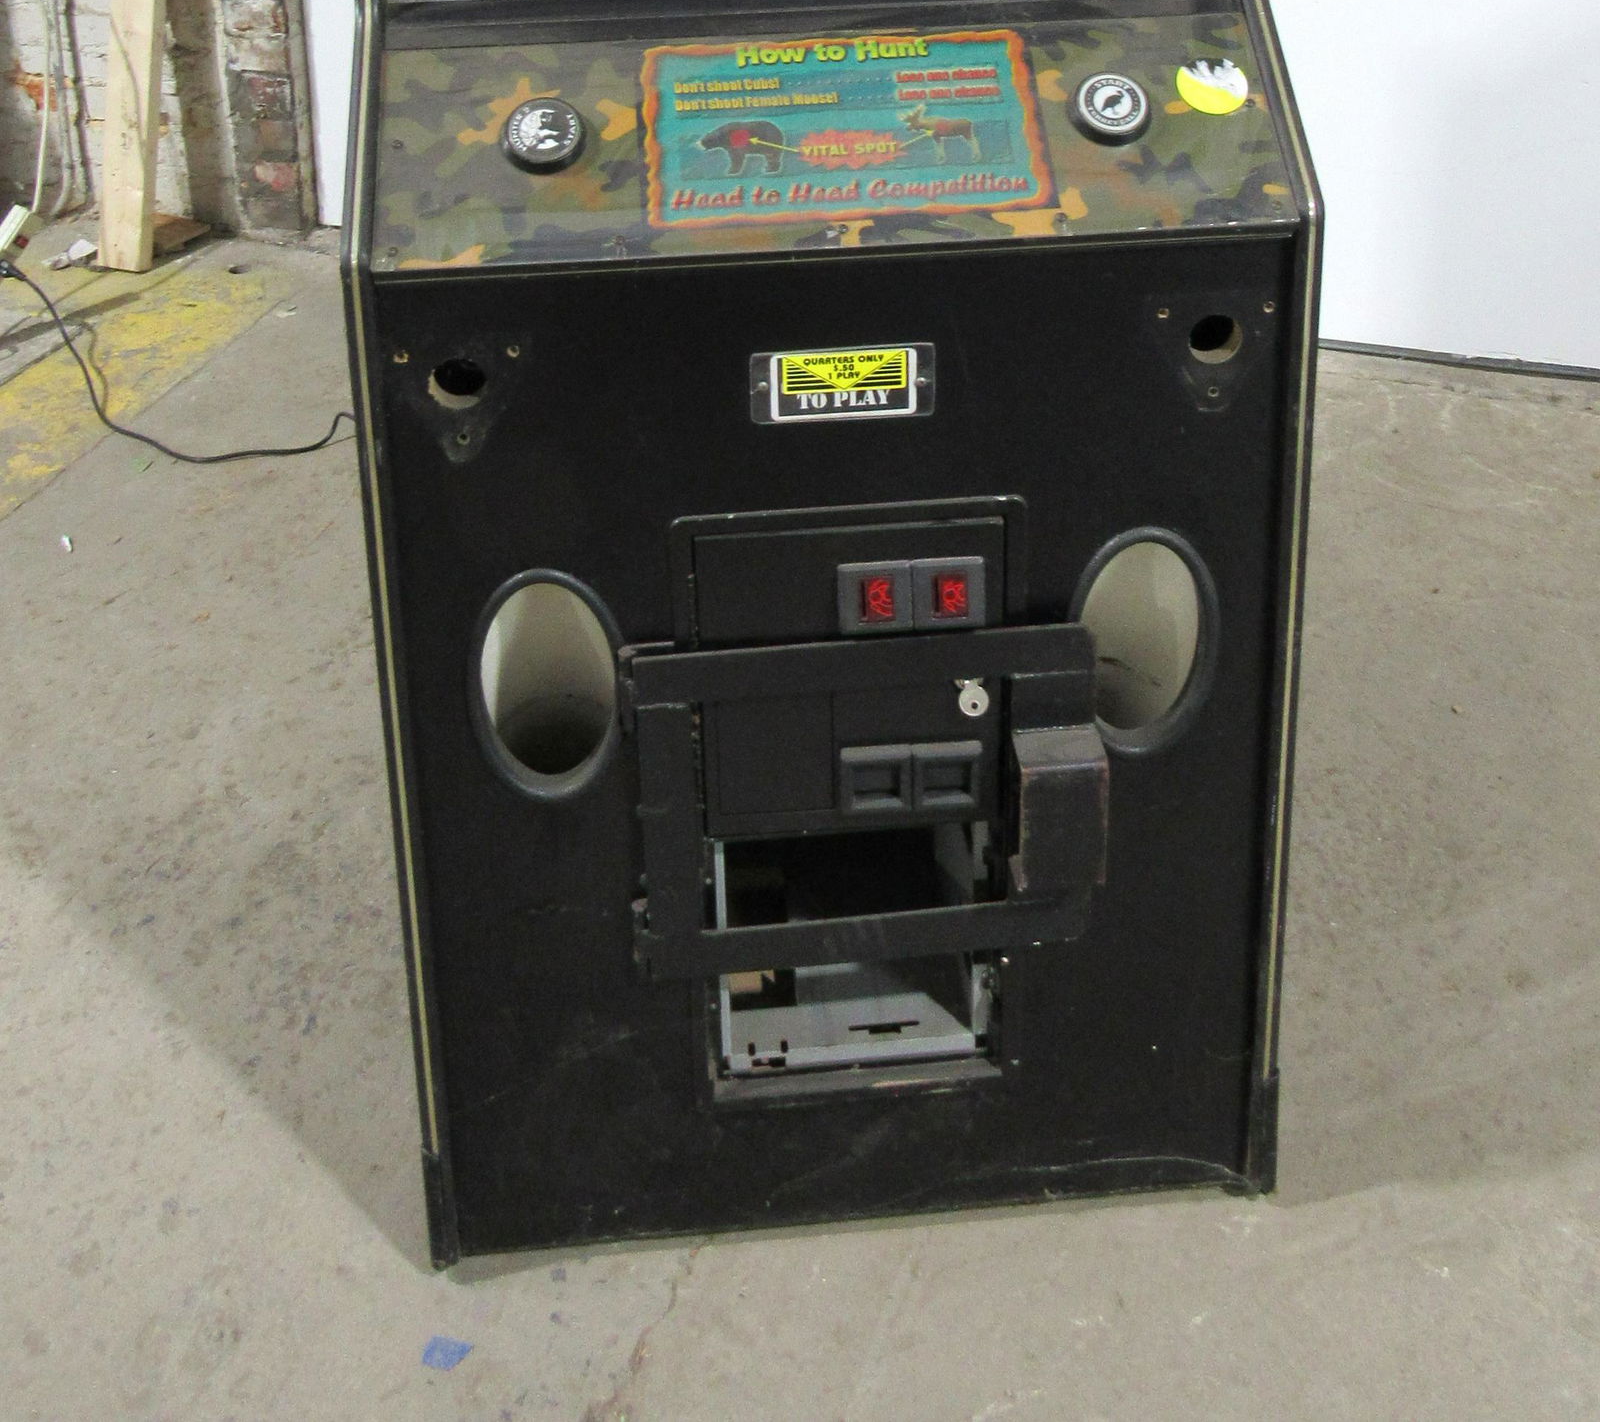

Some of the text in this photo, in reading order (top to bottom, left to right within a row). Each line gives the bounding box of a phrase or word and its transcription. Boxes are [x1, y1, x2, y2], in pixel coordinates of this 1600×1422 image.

[735, 38, 929, 68] How to Hunt
[802, 141, 897, 158] VITAL SPOT
[671, 172, 1030, 211] Head to Head Competition
[803, 354, 884, 366] QUARTERS ONLY
[836, 371, 861, 380] PLAY
[796, 389, 890, 409] TO PLAY
